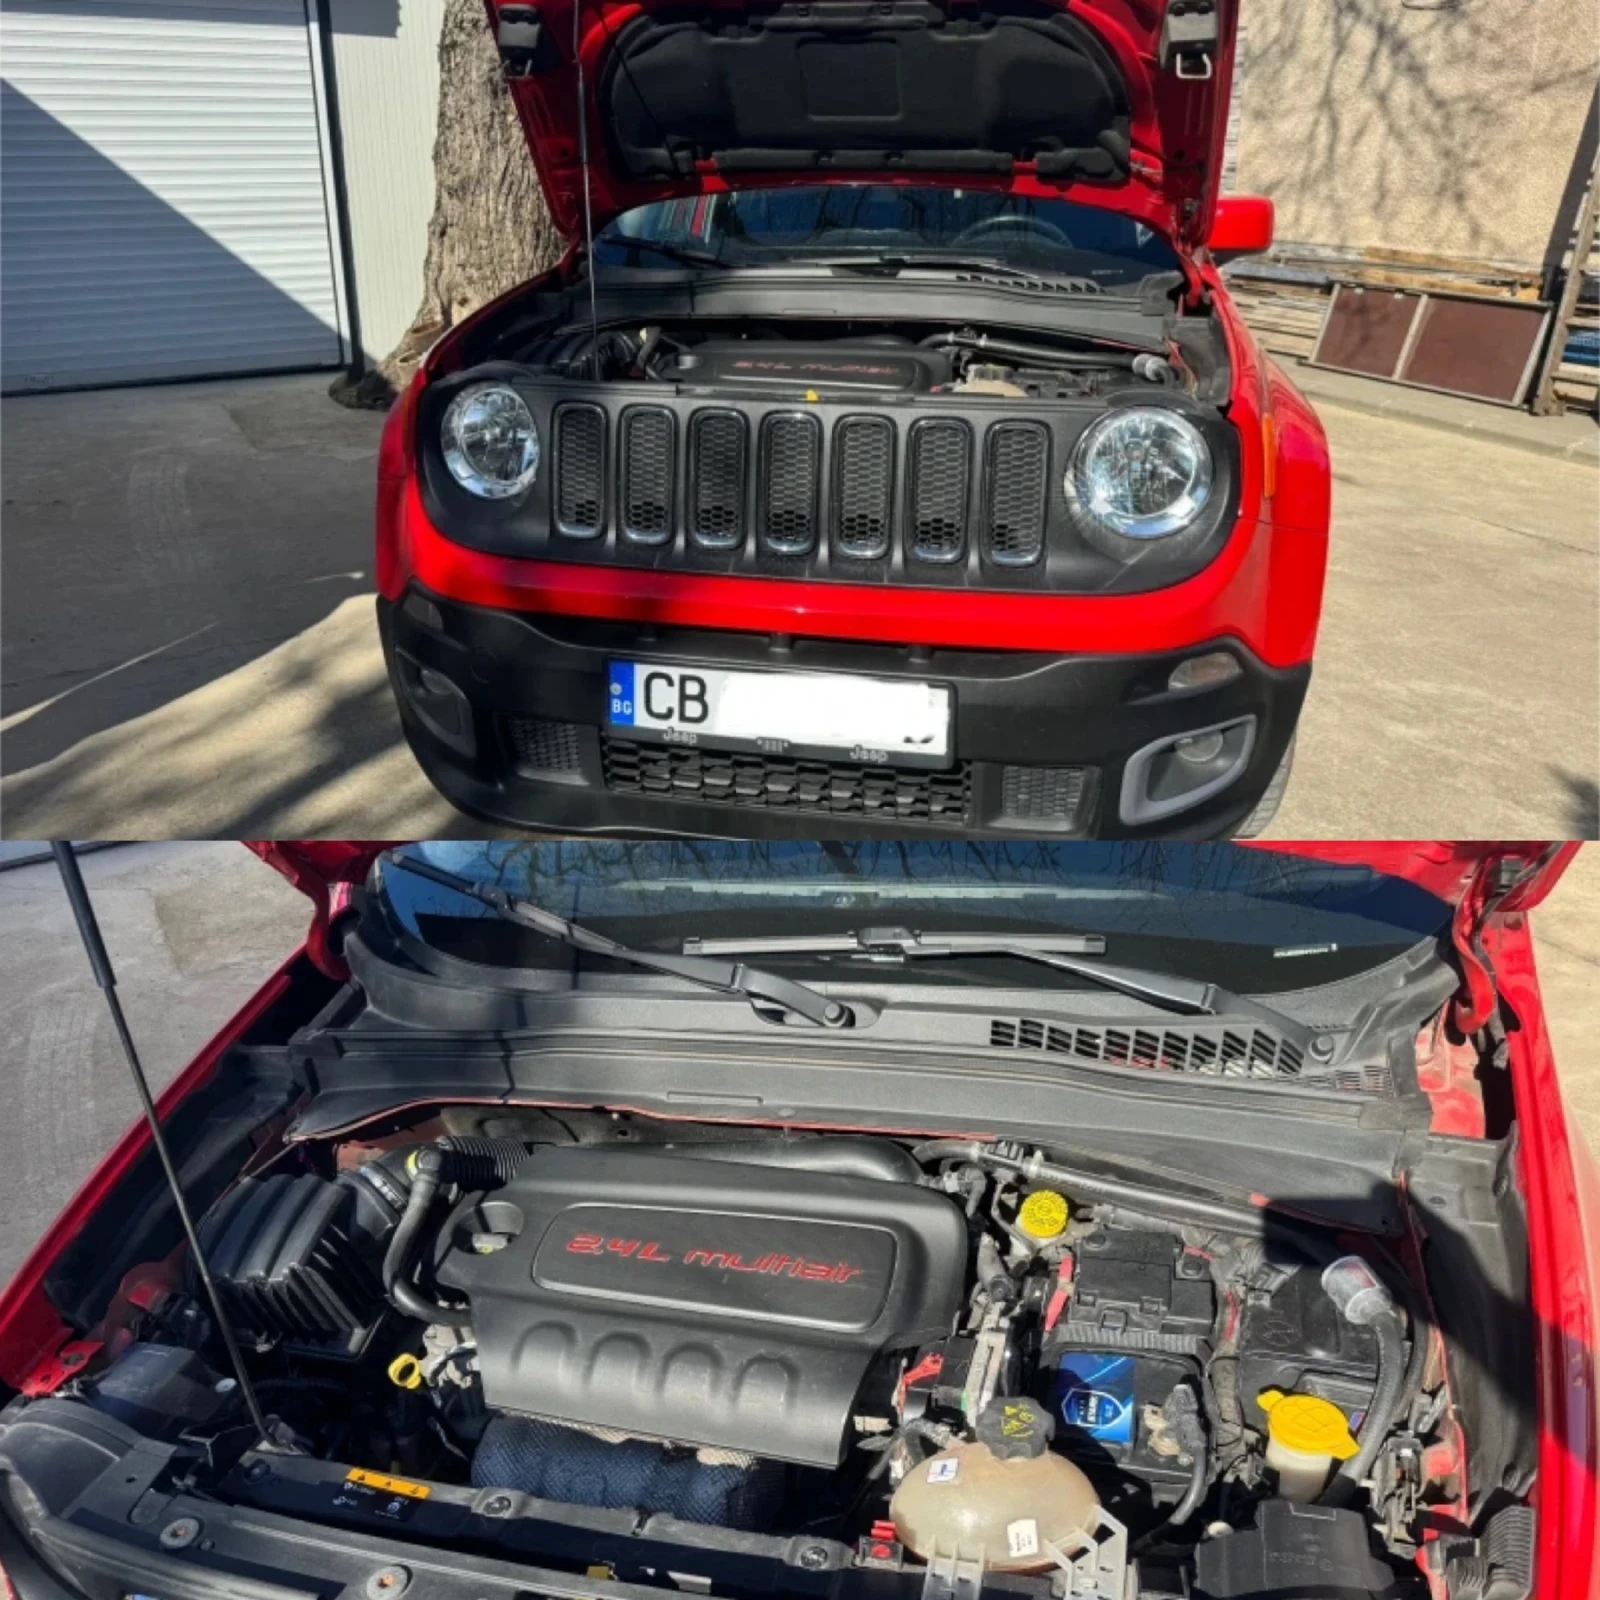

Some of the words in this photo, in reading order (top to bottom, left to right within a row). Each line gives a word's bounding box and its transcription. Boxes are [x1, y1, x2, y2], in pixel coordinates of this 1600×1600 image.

[644, 671, 709, 724] CB
[612, 699, 633, 716] BG
[663, 727, 697, 745] Jeep
[849, 745, 888, 764] Jeep
[682, 1248, 863, 1284] multiair
